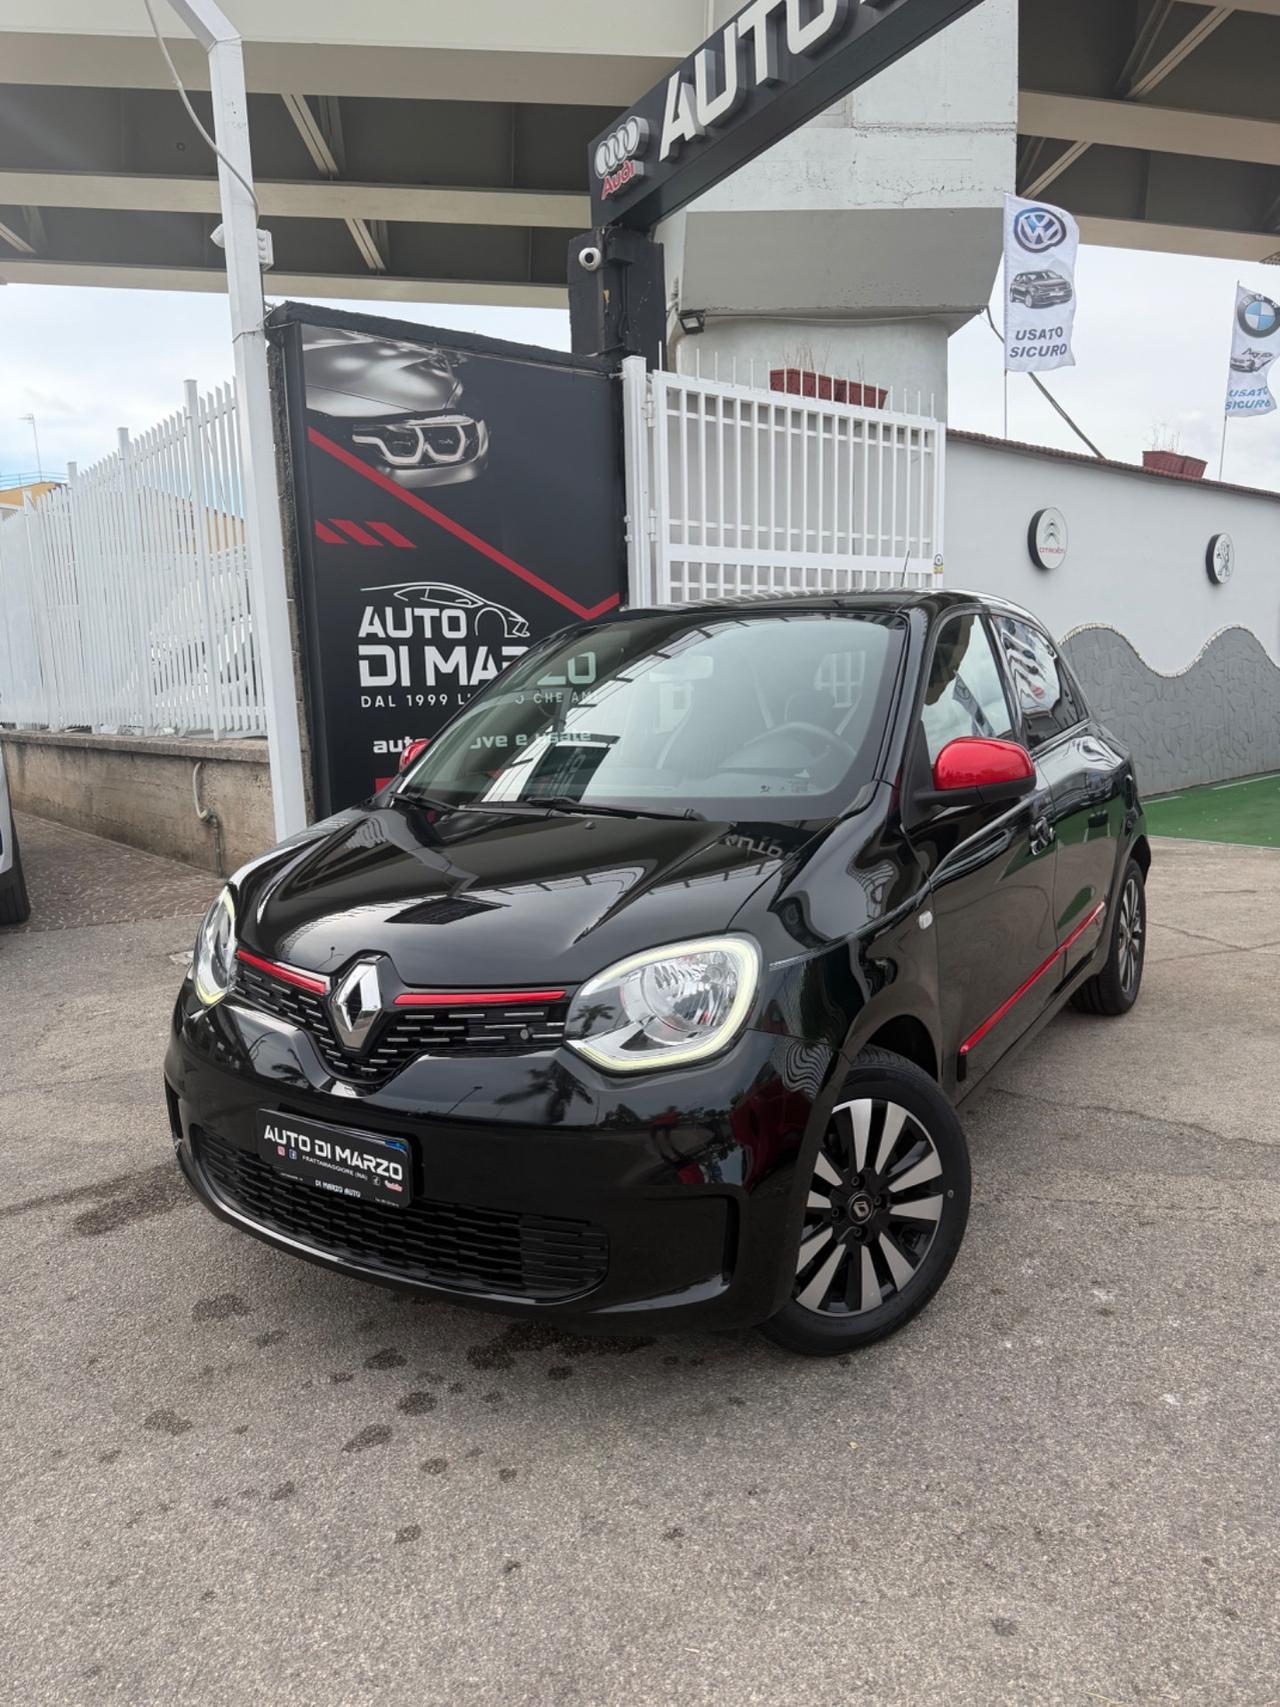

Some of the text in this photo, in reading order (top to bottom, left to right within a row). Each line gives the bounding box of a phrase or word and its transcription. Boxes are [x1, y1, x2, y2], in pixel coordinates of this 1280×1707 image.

[601, 160, 636, 200] Audi
[1015, 326, 1064, 341] USATO
[1009, 343, 1068, 358] SICURO
[358, 606, 468, 638] AUTO
[358, 645, 411, 687] DI
[360, 695, 397, 708] DAL
[406, 694, 448, 707] 1999
[373, 736, 413, 754] aut
[264, 1125, 403, 1181] AUTO DI MARZO
